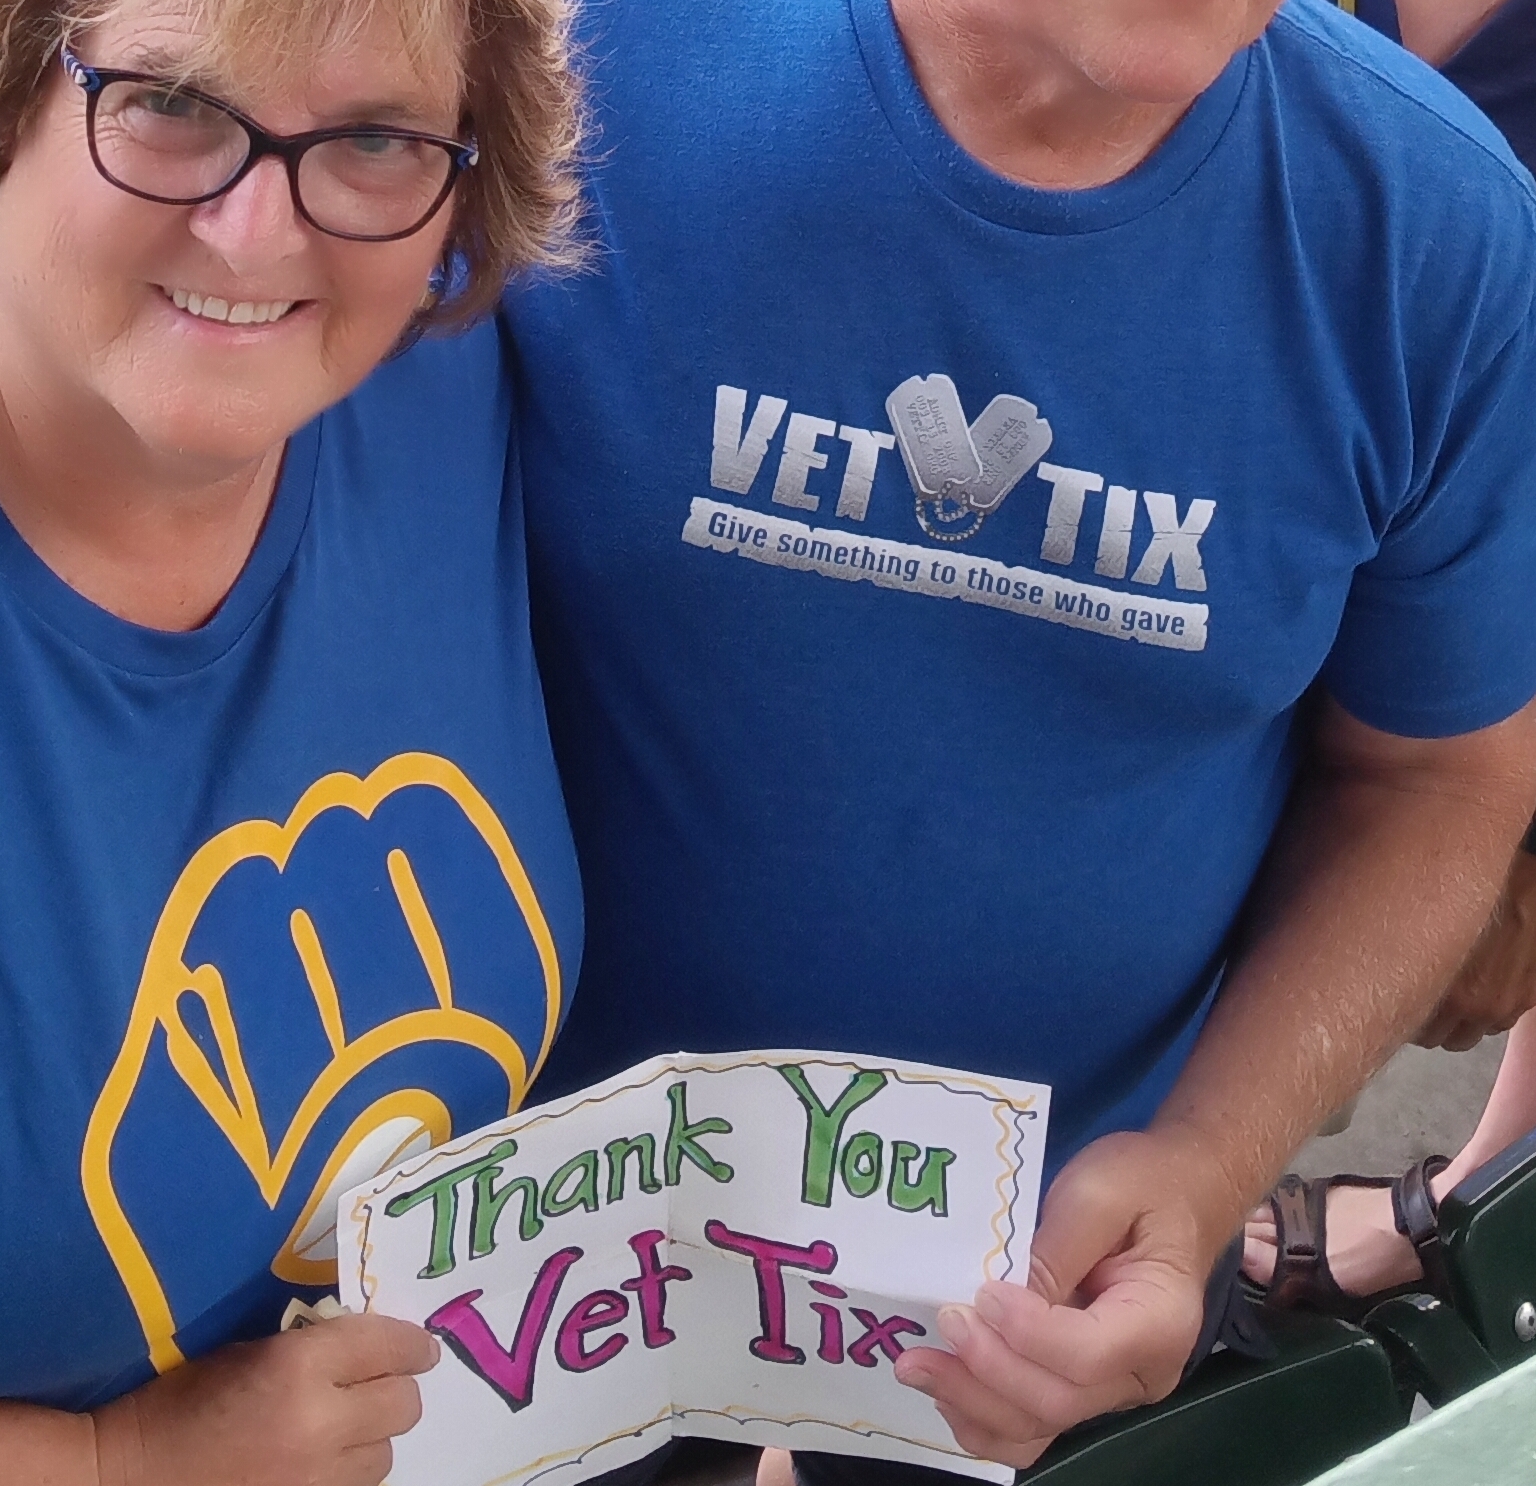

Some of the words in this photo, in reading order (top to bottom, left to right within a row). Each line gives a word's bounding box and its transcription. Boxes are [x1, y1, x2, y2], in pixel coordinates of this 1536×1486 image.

[707, 511, 768, 548] Give
[776, 532, 920, 582] something
[930, 559, 957, 585] to
[967, 566, 1044, 605] those
[1054, 589, 1111, 623] who
[1120, 607, 1186, 636] gave
[710, 384, 896, 522] VET
[1037, 461, 1217, 592] TIX
[383, 1081, 735, 1280] Thank
[776, 1064, 956, 1218] You
[423, 1228, 693, 1413] Vet
[704, 1218, 927, 1369] Tix
